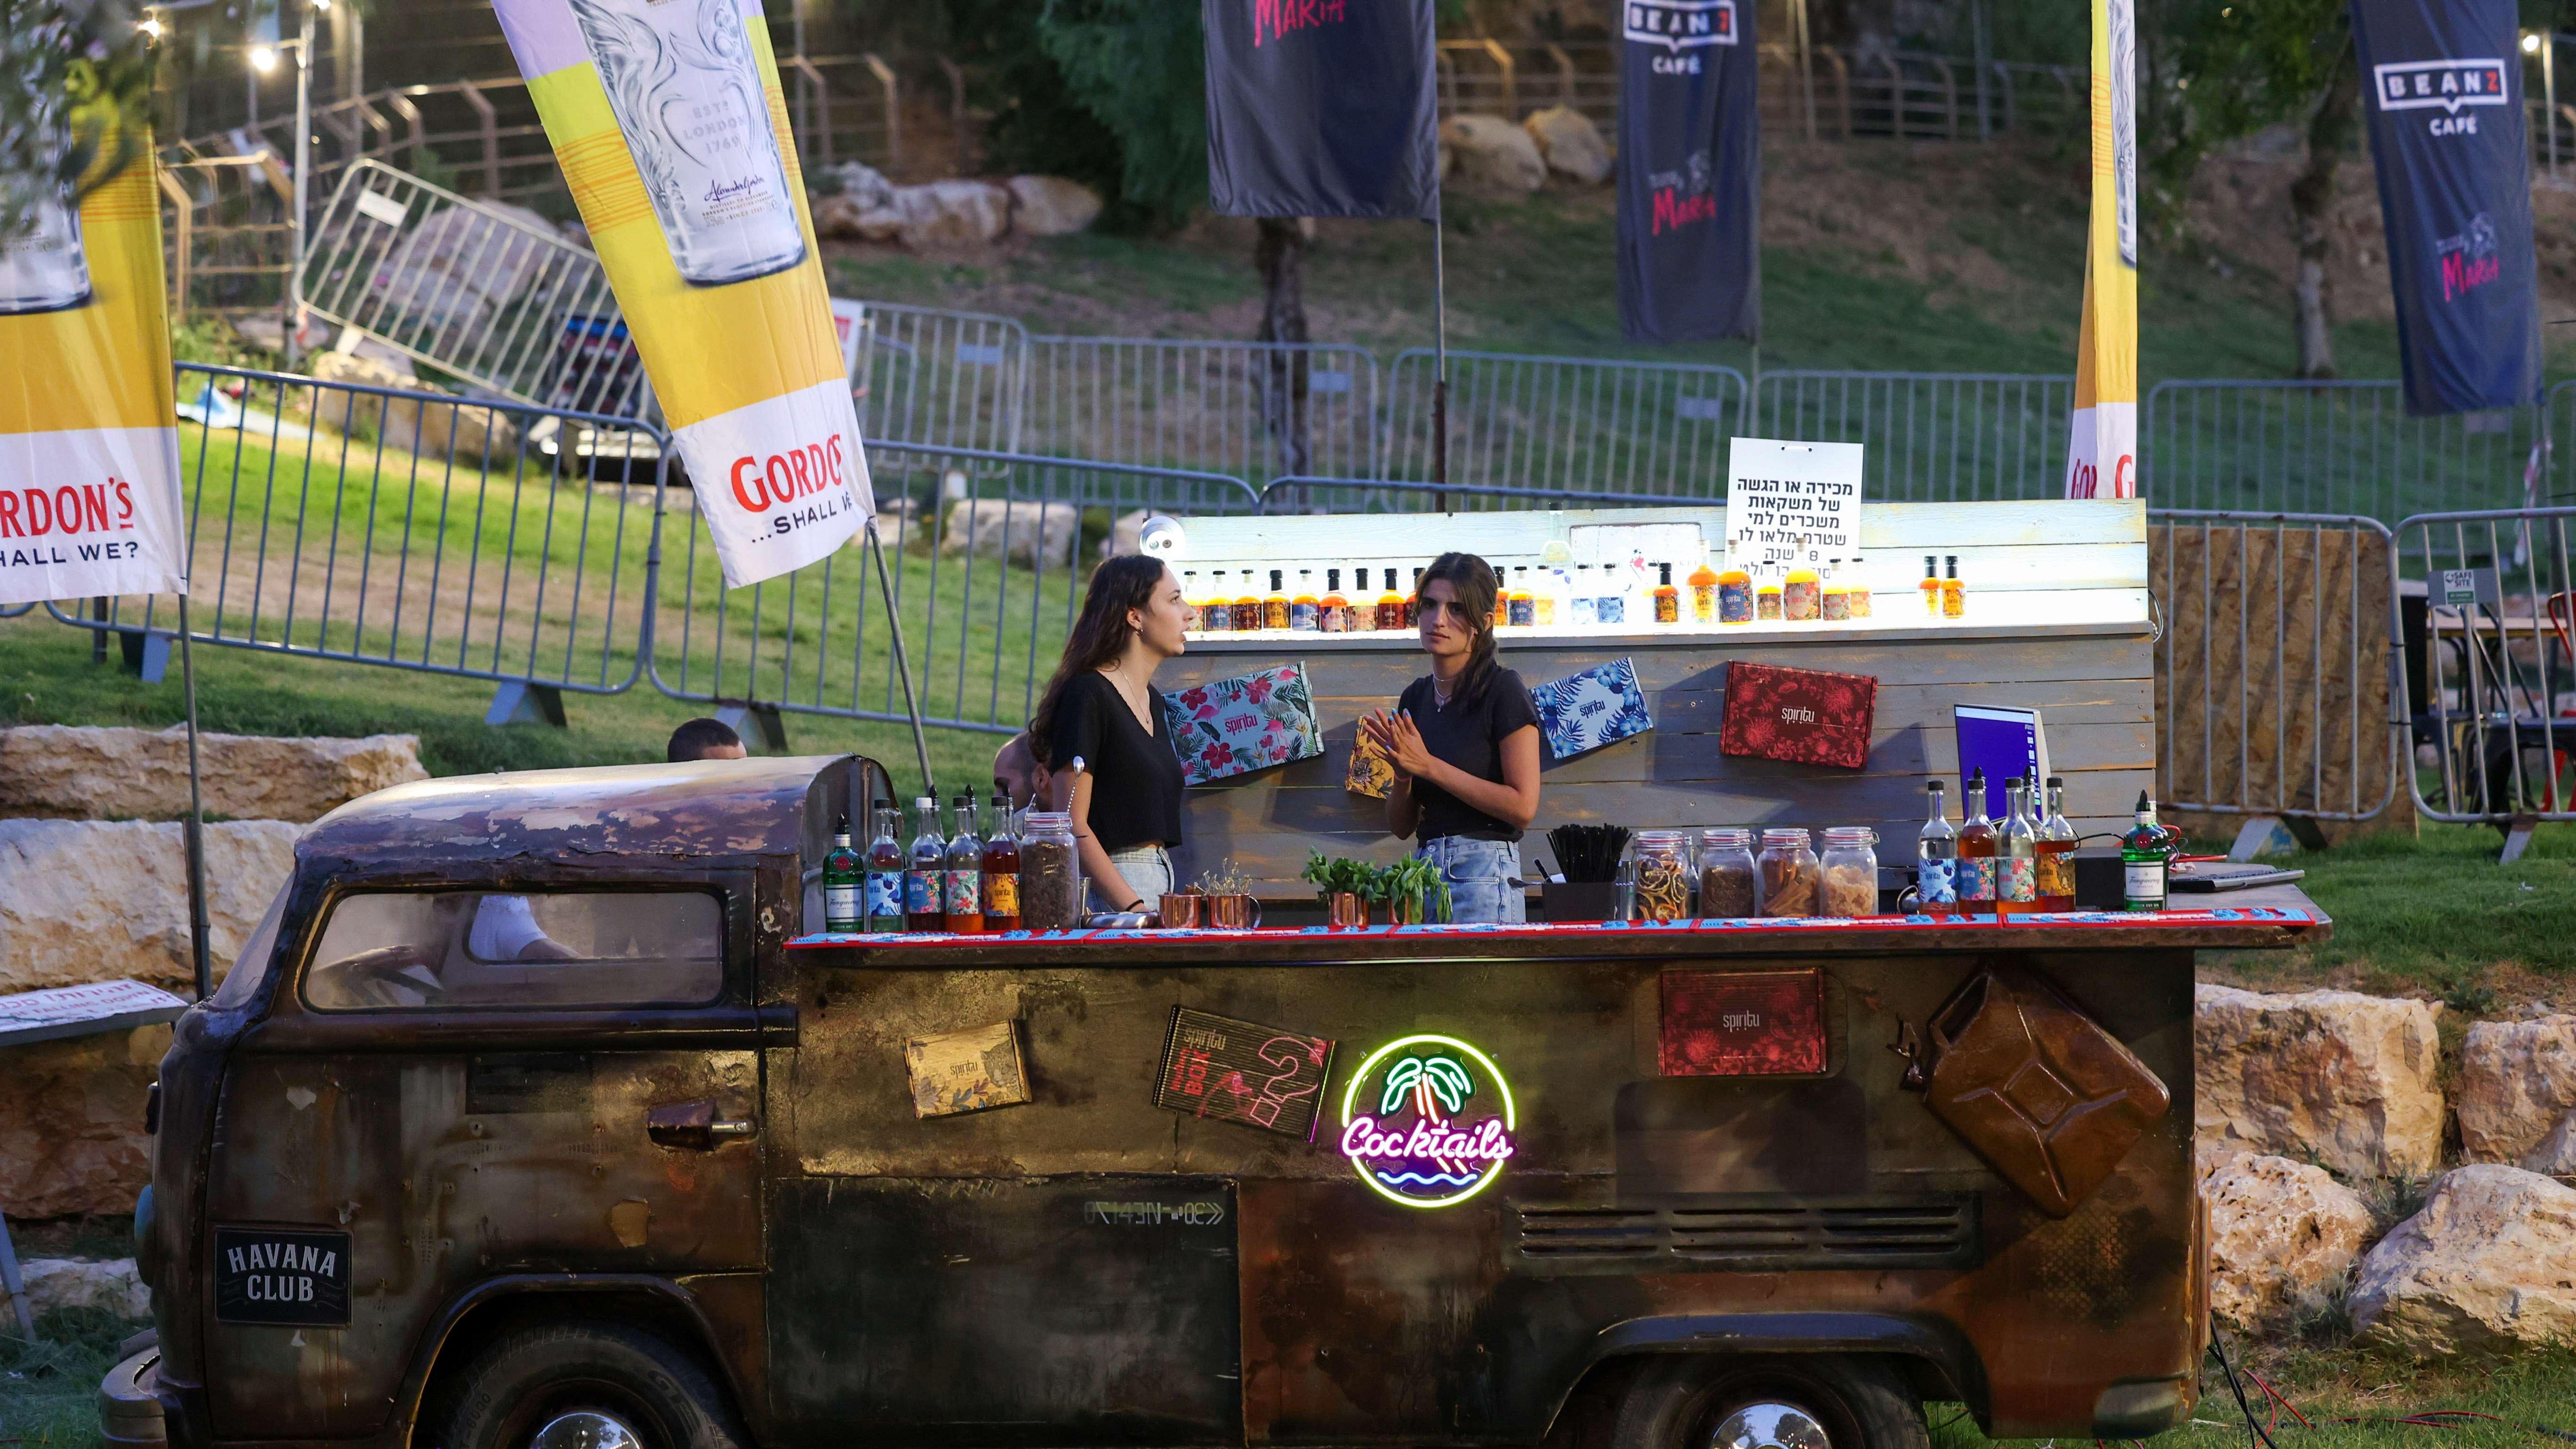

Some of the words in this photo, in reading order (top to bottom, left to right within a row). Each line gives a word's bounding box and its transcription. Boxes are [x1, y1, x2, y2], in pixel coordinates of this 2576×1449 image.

[683, 116, 746, 140] LONDON
[2430, 114, 2478, 137] CAFÉ
[1737, 479, 1779, 492] הגשה
[1785, 481, 1801, 493] או
[1806, 482, 1853, 495] מכירה
[1748, 496, 1812, 512] משקאות
[1819, 497, 1840, 512] של
[1748, 511, 1774, 525] למי
[1779, 515, 1840, 529] משכרים
[1739, 527, 1754, 542] לו
[1760, 529, 1797, 543] מלאו
[78, 541, 138, 561] WE?
[1765, 547, 1795, 560] שנה
[1808, 550, 1819, 562] 8
[2454, 572, 2472, 580] SAFE
[1580, 700, 1605, 718] spiritu
[1781, 706, 1814, 724] spiritu
[1225, 713, 1258, 736] spiritu
[1723, 1010, 1760, 1032] spiritu
[1183, 1028, 1226, 1050] spiritu
[950, 1060, 978, 1079] spiritu
[1342, 1117, 1513, 1159] Cocktails
[227, 1243, 336, 1278] HAVANA
[248, 1275, 313, 1301] CLUB
